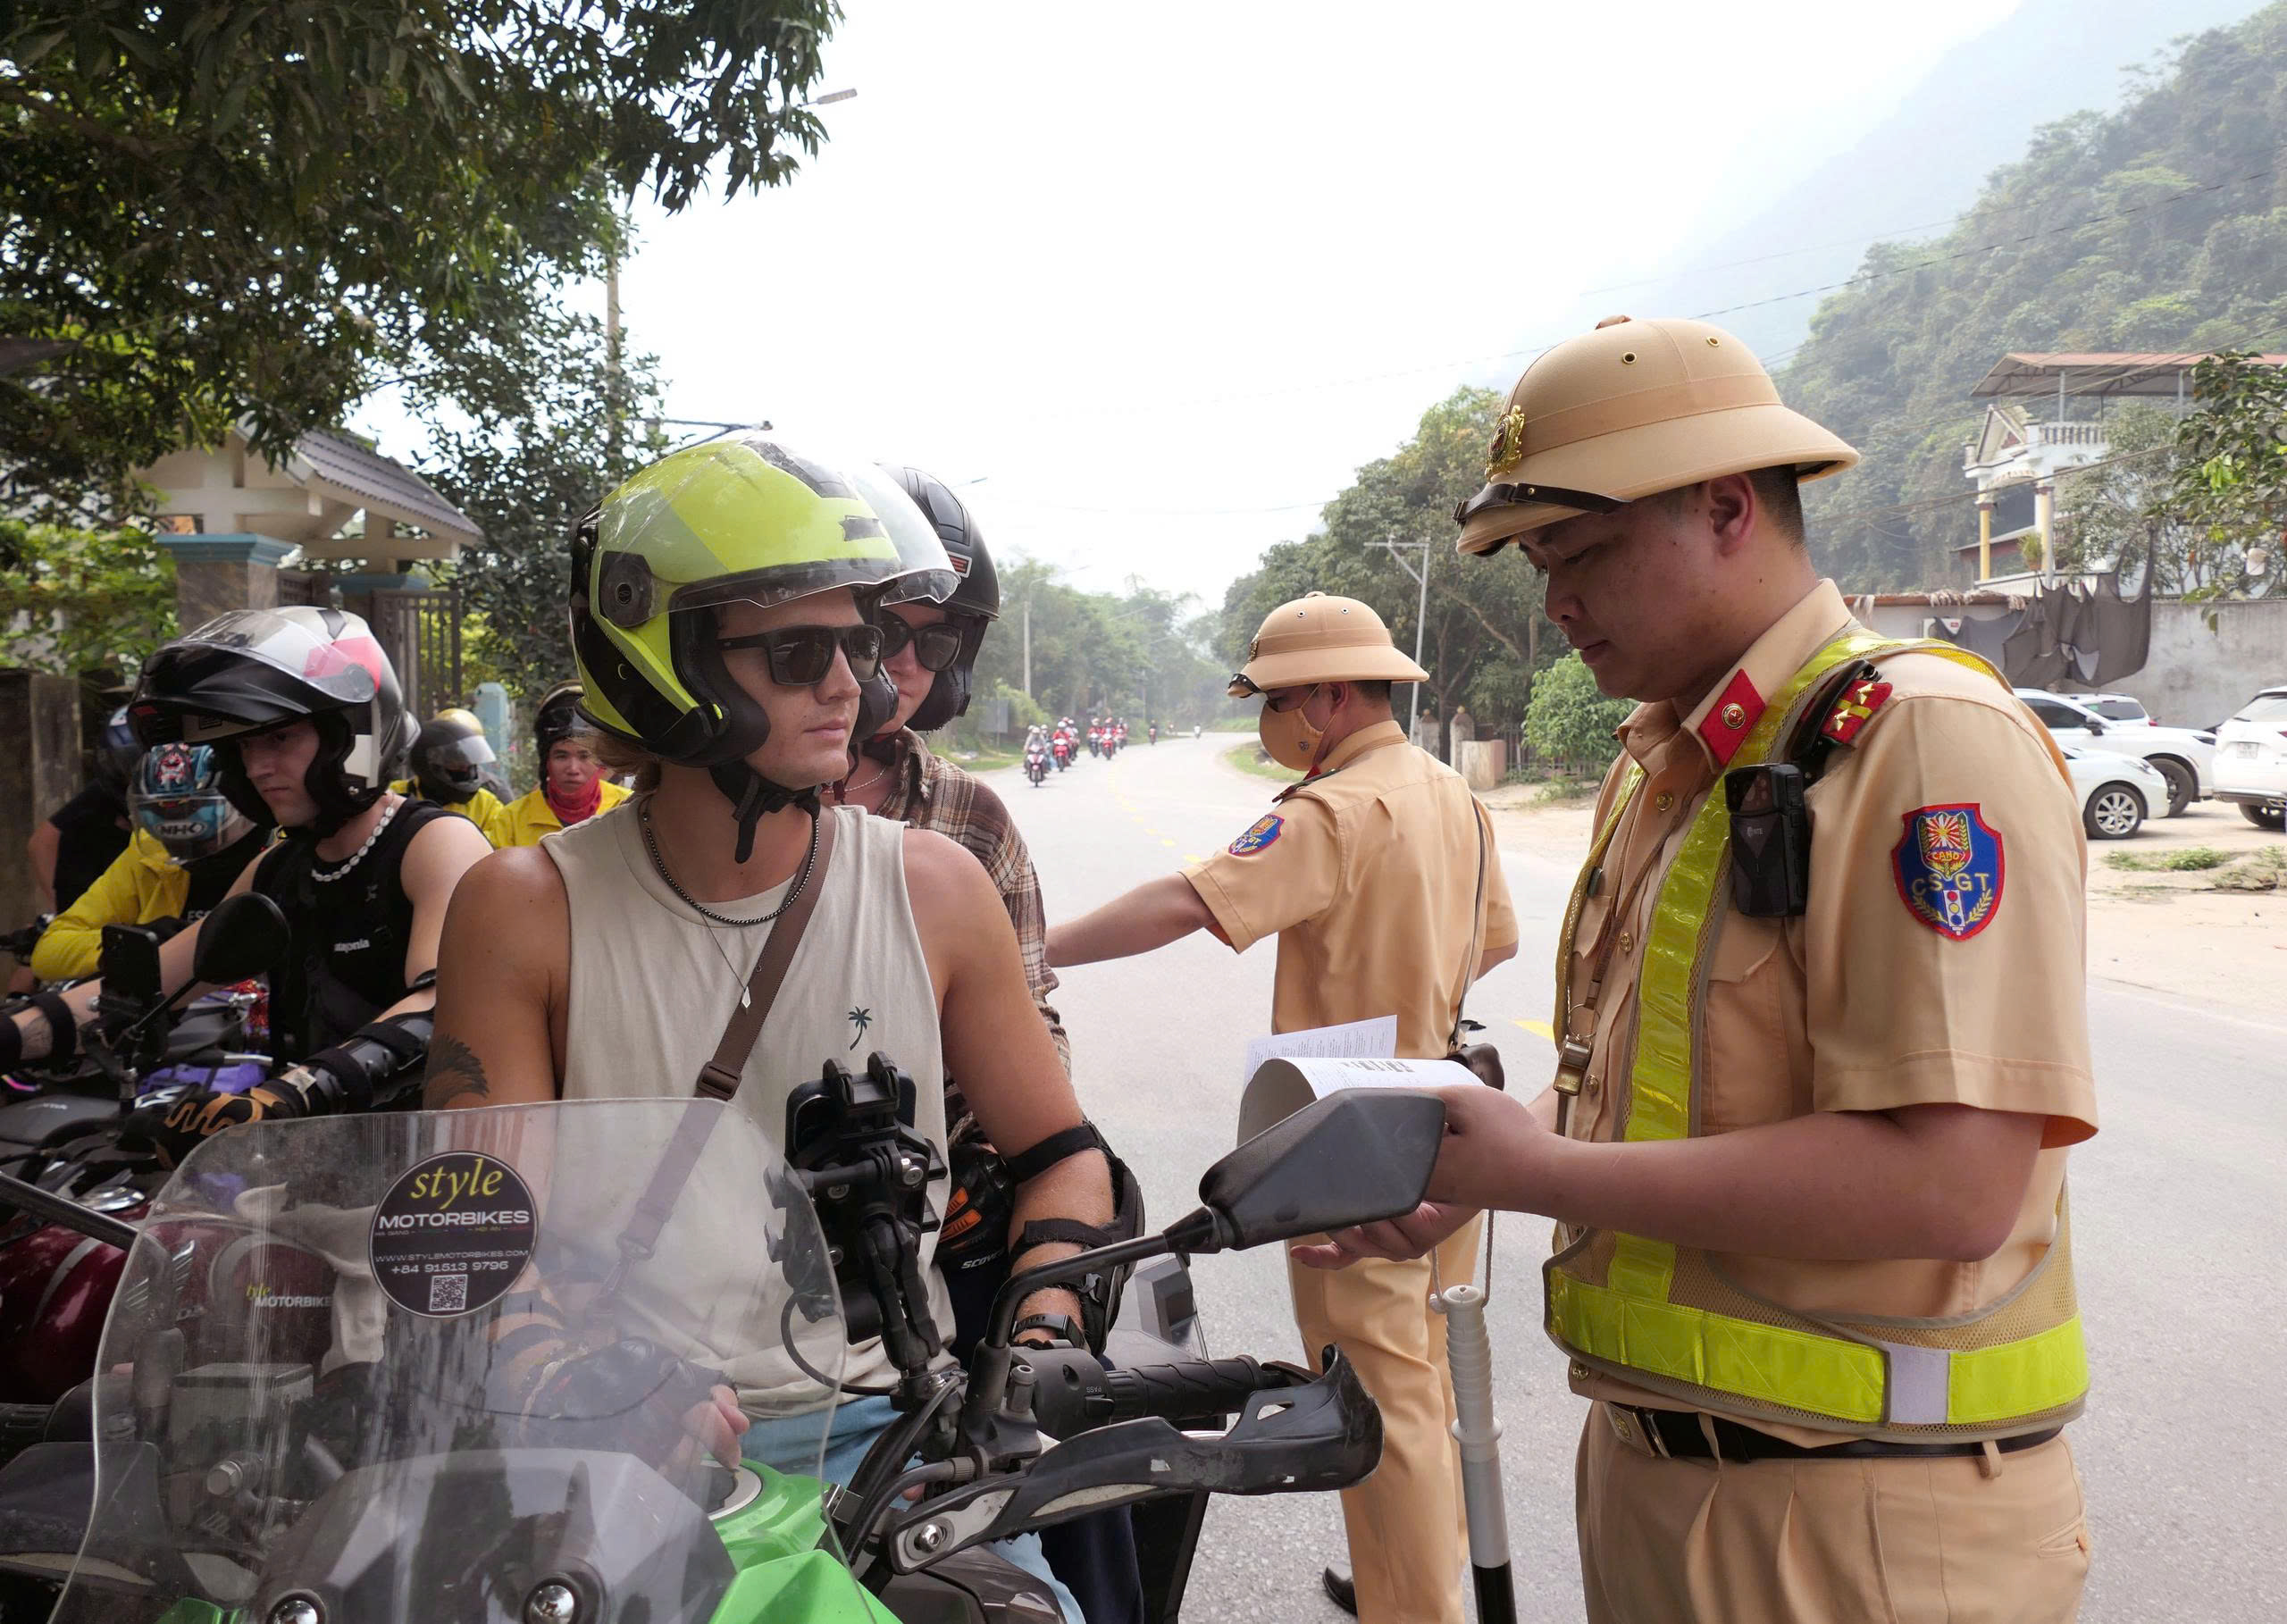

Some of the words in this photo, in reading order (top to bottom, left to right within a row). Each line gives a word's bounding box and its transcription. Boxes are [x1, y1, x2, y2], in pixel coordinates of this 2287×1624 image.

[410, 1158, 503, 1210] style
[379, 1210, 530, 1229] MOTORBIKES
[375, 1249, 529, 1262] WWW.STYLEMOTORBIKES.COM
[391, 1262, 419, 1275] +84
[424, 1261, 468, 1273] 91513
[472, 1260, 509, 1271] 9796
[254, 1295, 333, 1308] MOTORBIKE
